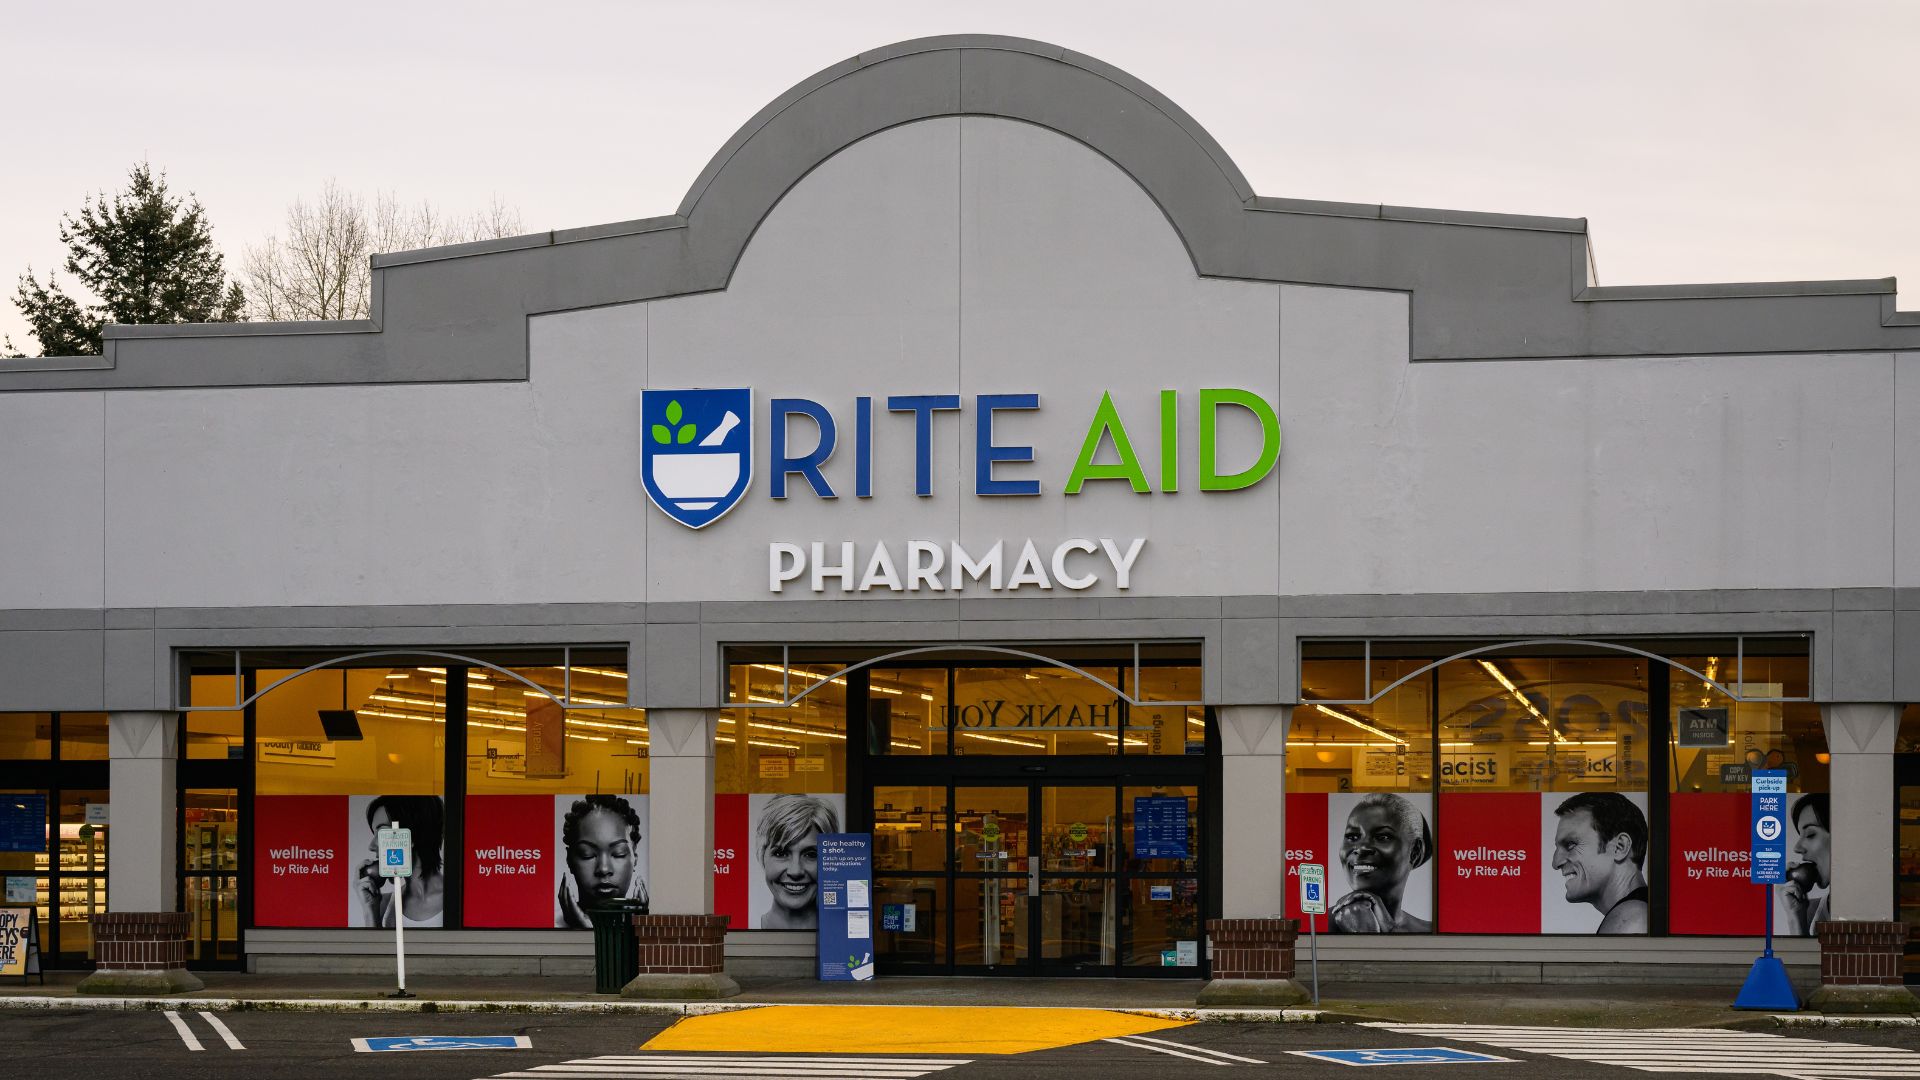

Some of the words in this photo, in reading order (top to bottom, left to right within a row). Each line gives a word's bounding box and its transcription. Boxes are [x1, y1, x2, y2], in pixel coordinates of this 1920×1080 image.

[769, 393, 1041, 498] RITE
[1064, 388, 1282, 495] AID
[769, 537, 1148, 592] PHARMACY
[1689, 718, 1718, 729] ATM
[533, 721, 545, 757] beauty
[1152, 714, 1164, 754] reetings
[488, 749, 496, 758] 13
[638, 749, 646, 757] 14
[788, 749, 796, 757] 15
[1442, 757, 1496, 776] acist
[1730, 766, 1744, 774] COPY
[1340, 777, 1349, 789] 2
[1725, 774, 1737, 782] ANY
[1737, 774, 1749, 782] KEY
[839, 840, 866, 848] healthy
[270, 846, 334, 860] wellness
[475, 846, 541, 860] wellness
[1285, 849, 1314, 861] ess
[1453, 846, 1527, 861] wellness
[273, 864, 286, 876] by
[288, 864, 310, 874] Rite
[311, 864, 329, 874] Aid
[478, 864, 491, 876] by
[494, 864, 516, 875] Rite
[517, 864, 536, 875] Aid
[1457, 865, 1472, 877] by
[1475, 865, 1498, 876] Rite
[1500, 865, 1521, 876] Aid
[1687, 867, 1702, 879] by
[1705, 867, 1728, 877] Rite
[1731, 867, 1751, 877] Aid
